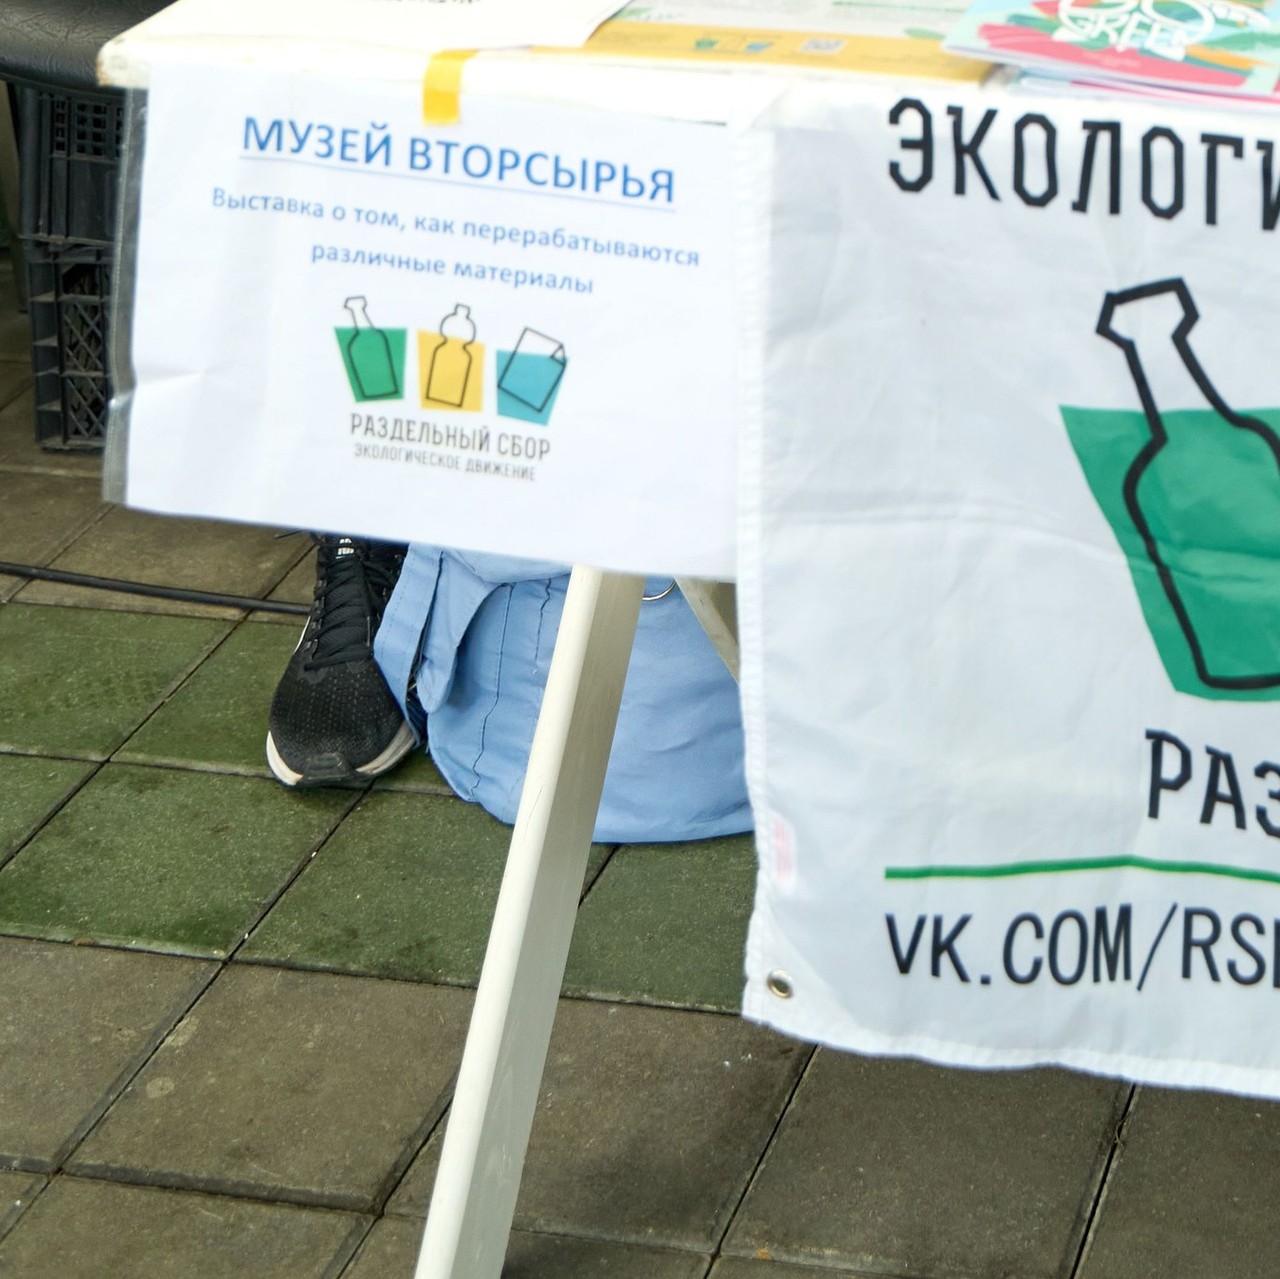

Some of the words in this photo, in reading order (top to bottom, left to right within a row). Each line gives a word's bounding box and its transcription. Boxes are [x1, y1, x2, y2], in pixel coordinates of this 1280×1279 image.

[242, 116, 392, 167] МУЗЕЙ
[408, 137, 675, 203] ВТОРСЫРЬЯ
[211, 187, 324, 220] Выставка
[332, 204, 346, 221] о
[354, 207, 406, 232] том,
[414, 214, 455, 235] как
[463, 221, 700, 267] перерабатываются
[310, 243, 446, 275] различные
[453, 261, 594, 295] материалы
[350, 412, 490, 453] РАЗДЕЛЬНЫЙ
[497, 432, 551, 461] СБОР
[354, 442, 460, 471] ЭКОЛОГИЧЕСКОЕ
[465, 457, 537, 482] ДВИЖЕНИЕ
